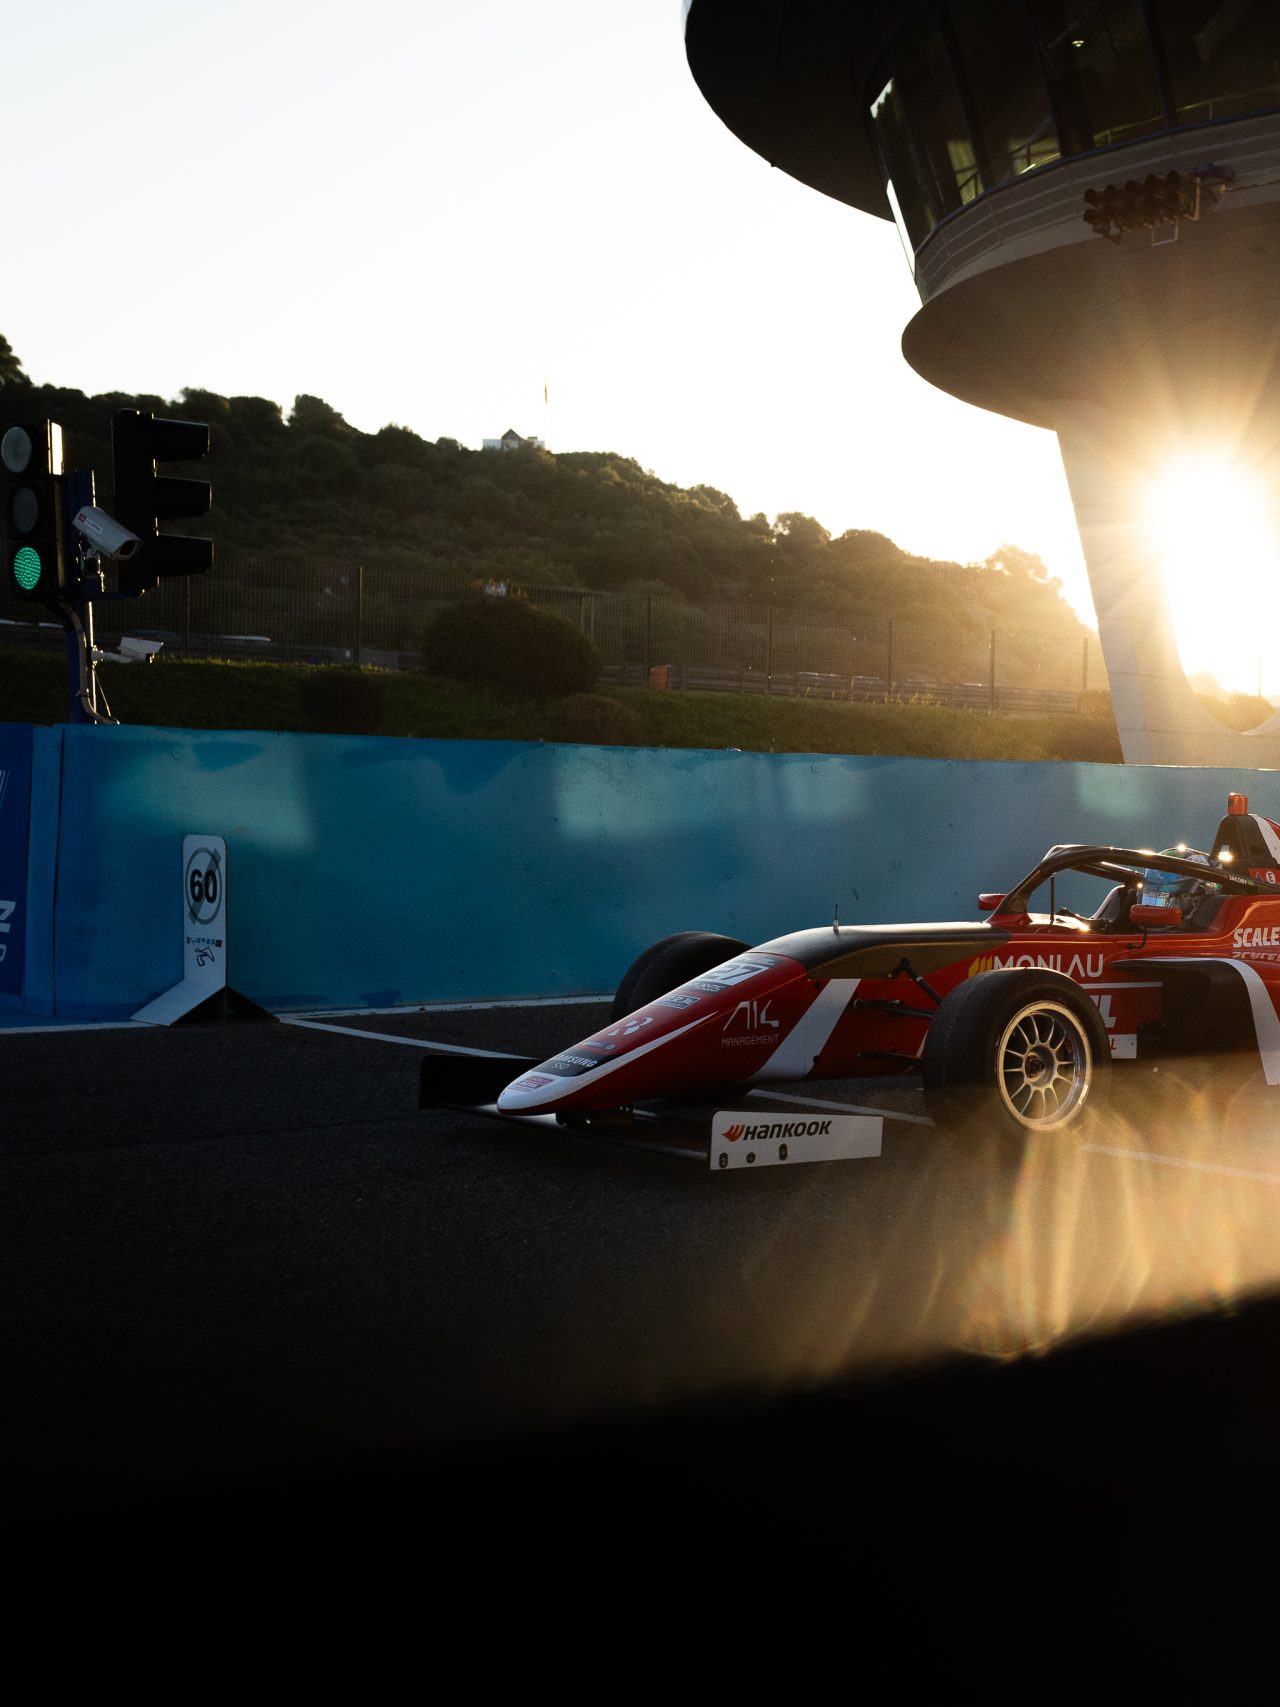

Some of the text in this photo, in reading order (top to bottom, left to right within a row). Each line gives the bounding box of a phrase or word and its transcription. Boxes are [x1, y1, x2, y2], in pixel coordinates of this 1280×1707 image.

[190, 869, 217, 903] 60
[993, 954, 1104, 978] MONLAU
[721, 1033, 780, 1048] MANAGEMENT
